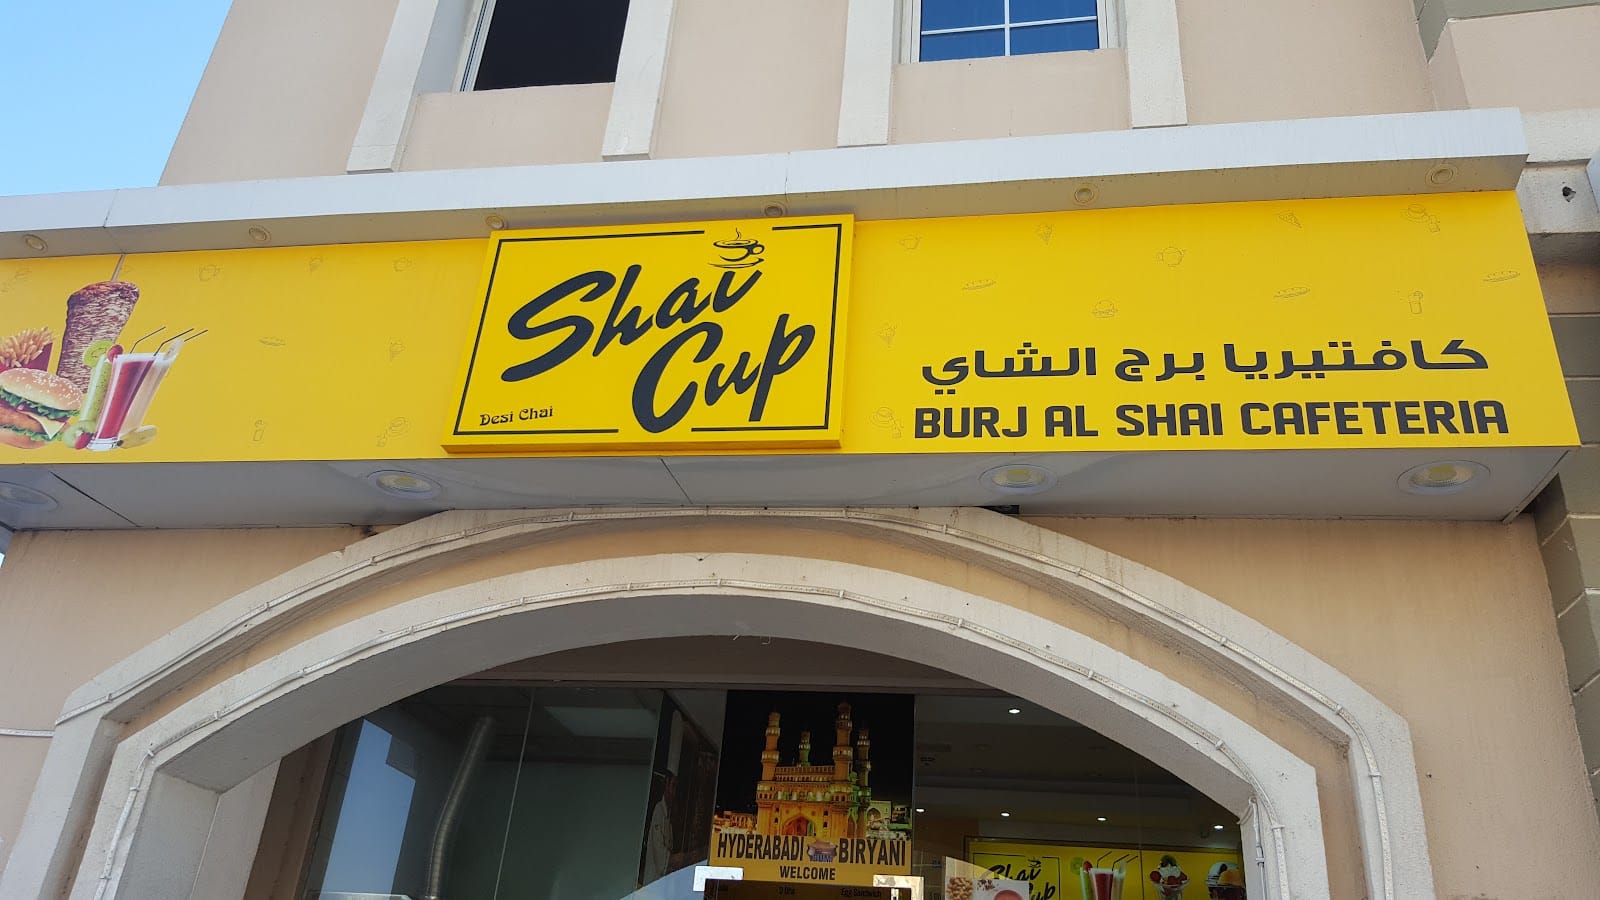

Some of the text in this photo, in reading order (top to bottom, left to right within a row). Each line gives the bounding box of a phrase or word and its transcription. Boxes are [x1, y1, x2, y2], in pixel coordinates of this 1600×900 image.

[501, 264, 763, 382] Shai
[632, 314, 815, 433] Cup
[923, 340, 1488, 395] كافتيريا برج الشاي
[479, 405, 554, 426] Desi Chai
[915, 401, 1509, 438] BURJ AL SHAI CAFETERIA
[717, 833, 805, 861] HYDERABADI
[838, 838, 906, 866] BIRYANI
[780, 865, 836, 881] WELCOME
